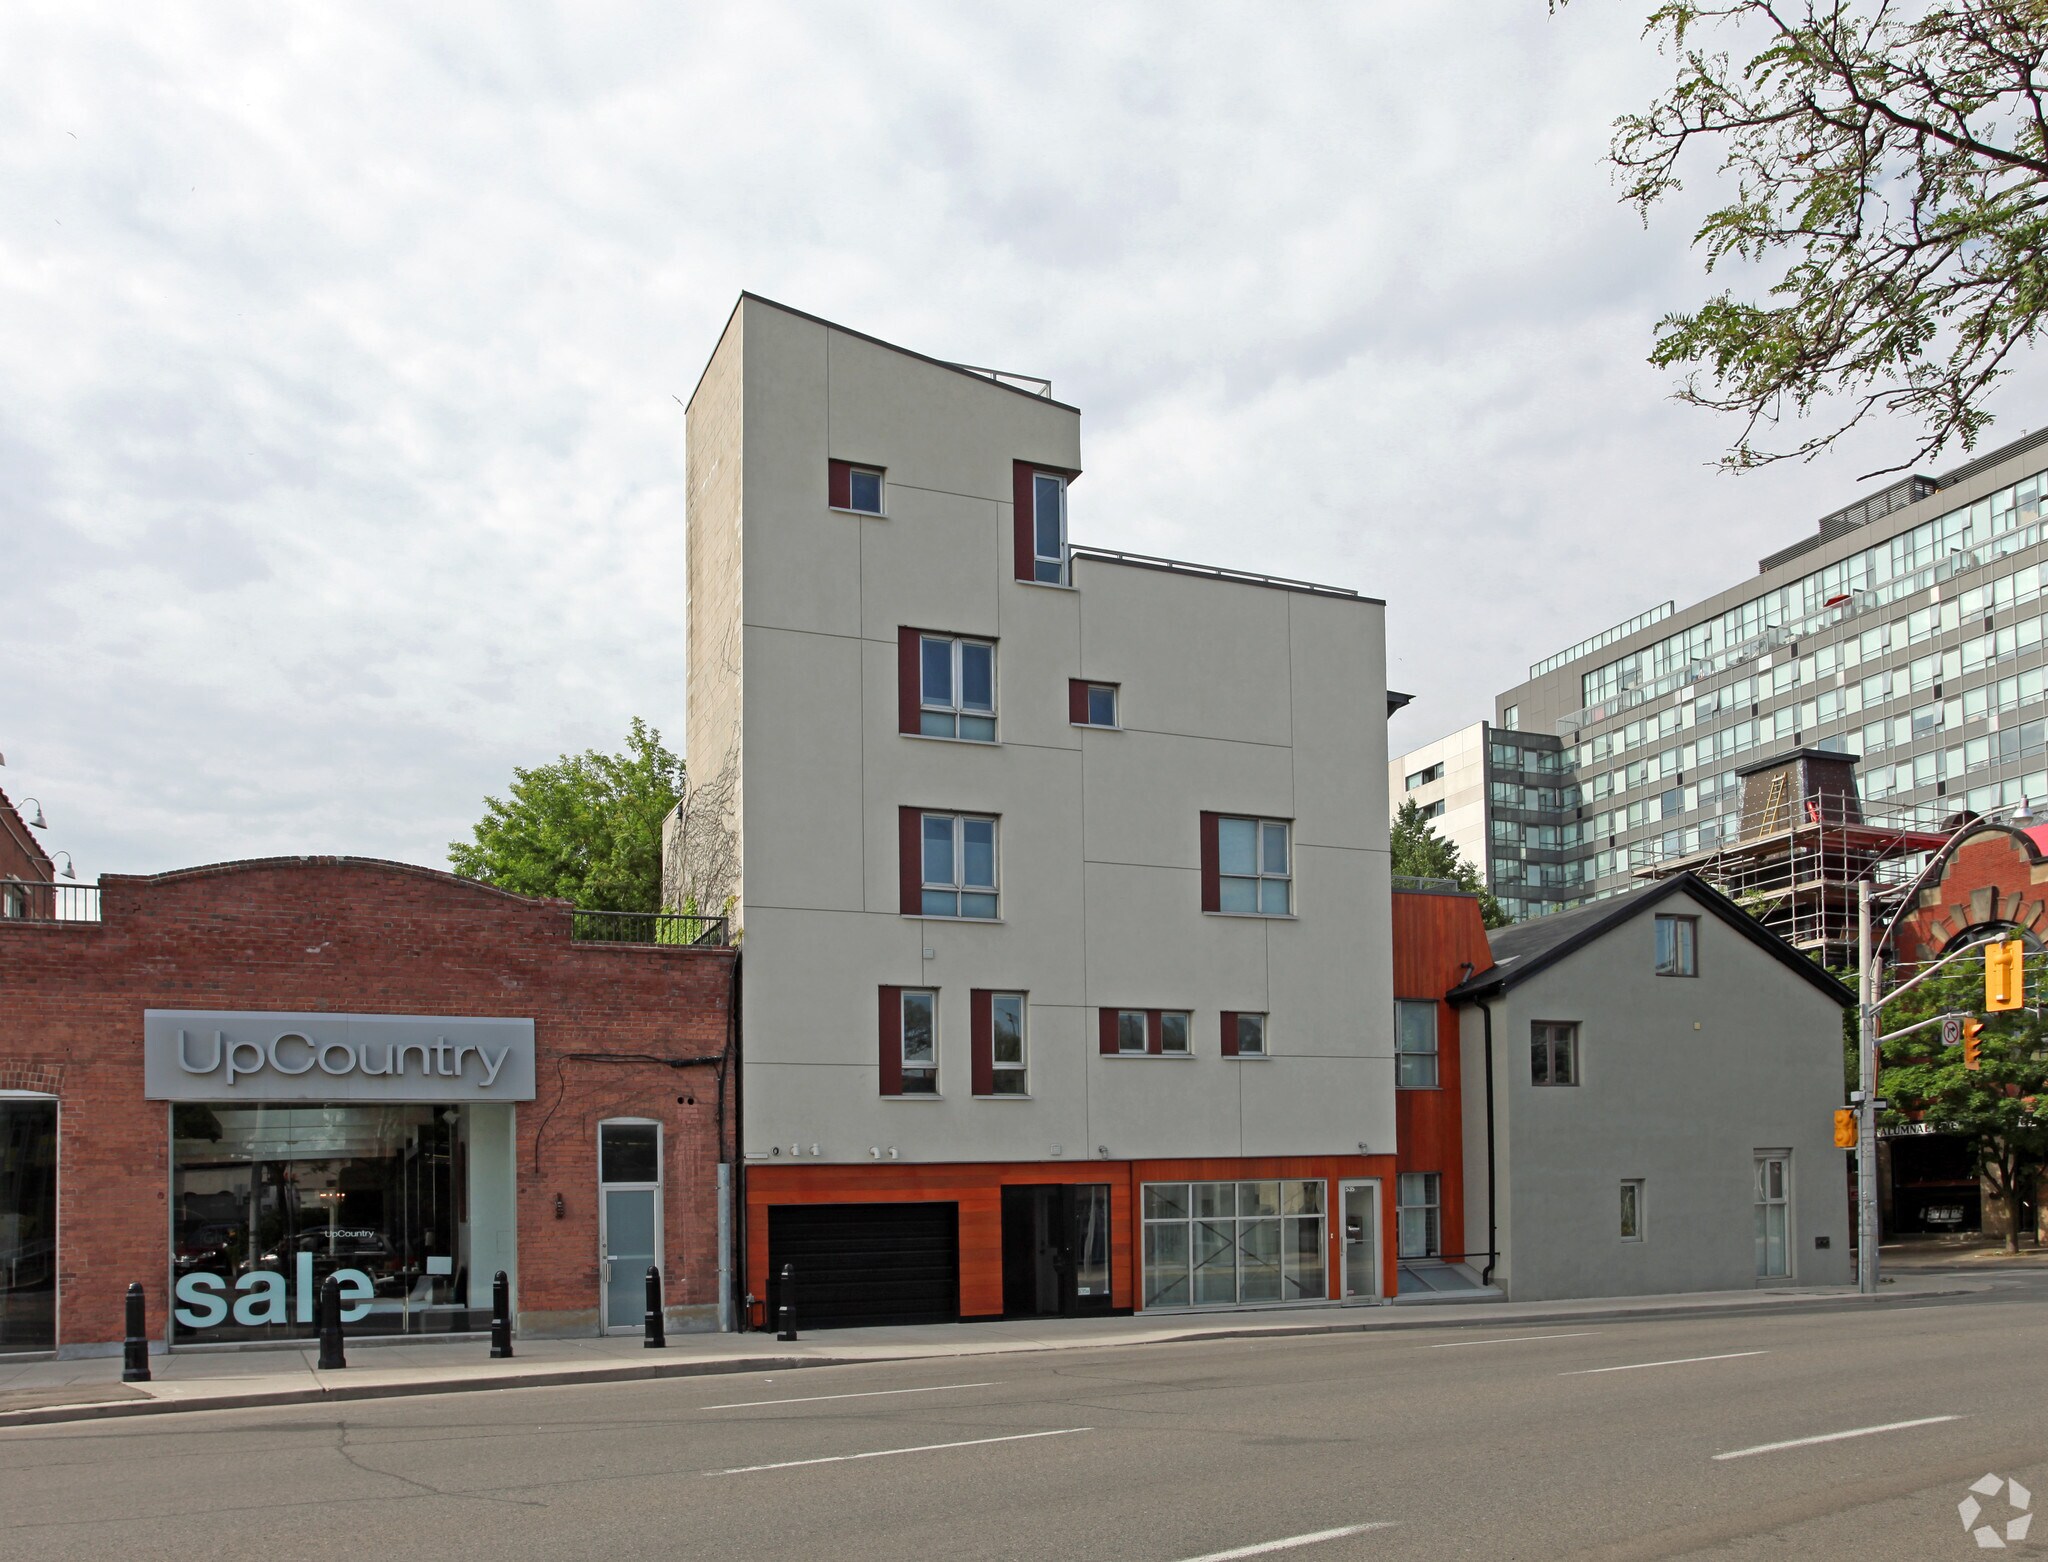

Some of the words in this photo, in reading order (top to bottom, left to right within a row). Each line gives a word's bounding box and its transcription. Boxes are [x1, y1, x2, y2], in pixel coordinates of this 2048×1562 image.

[178, 1029, 511, 1087] UpCountry
[1880, 1123, 1928, 1137] ALUMNAE
[324, 1229, 374, 1239] UpCountry
[174, 1251, 375, 1328] sale
